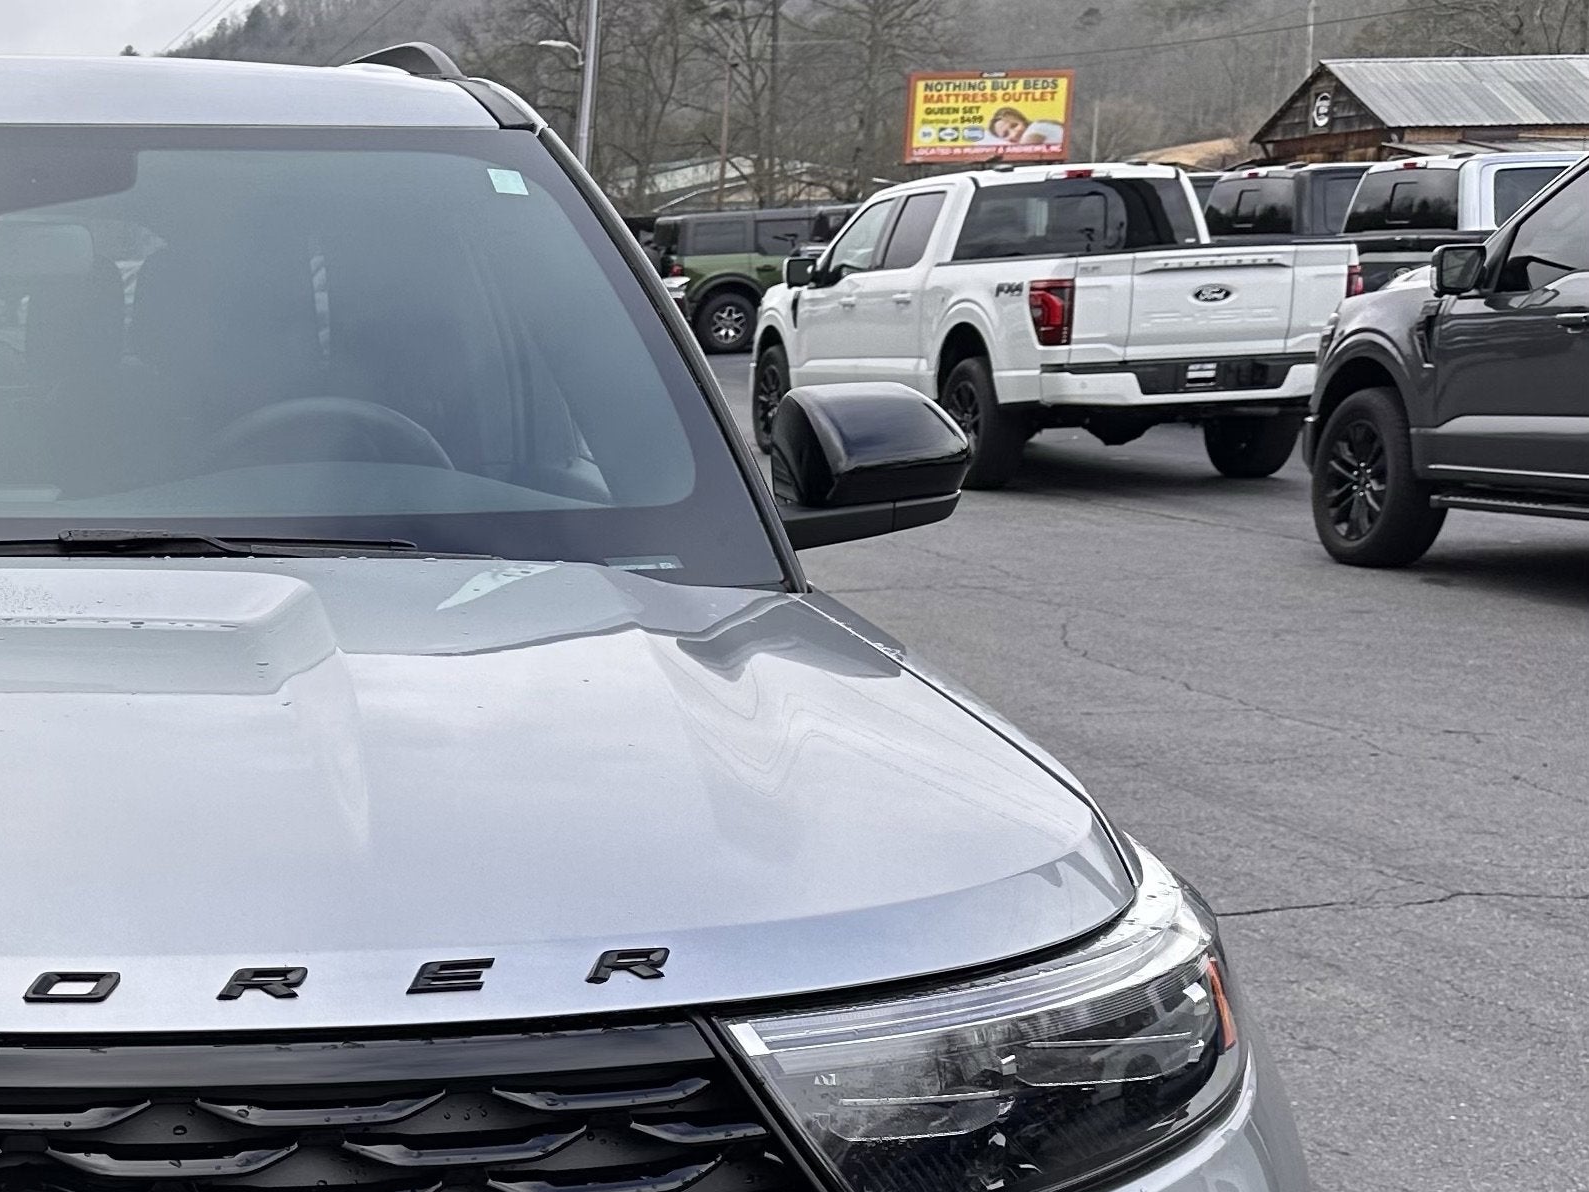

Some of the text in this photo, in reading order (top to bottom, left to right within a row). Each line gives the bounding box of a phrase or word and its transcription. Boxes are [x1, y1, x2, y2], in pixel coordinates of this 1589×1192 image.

[924, 79, 1059, 92] NOTHING BUT BEDS
[923, 91, 1057, 104] MATTRESS OUTLET
[924, 105, 981, 115] QUEEN SET
